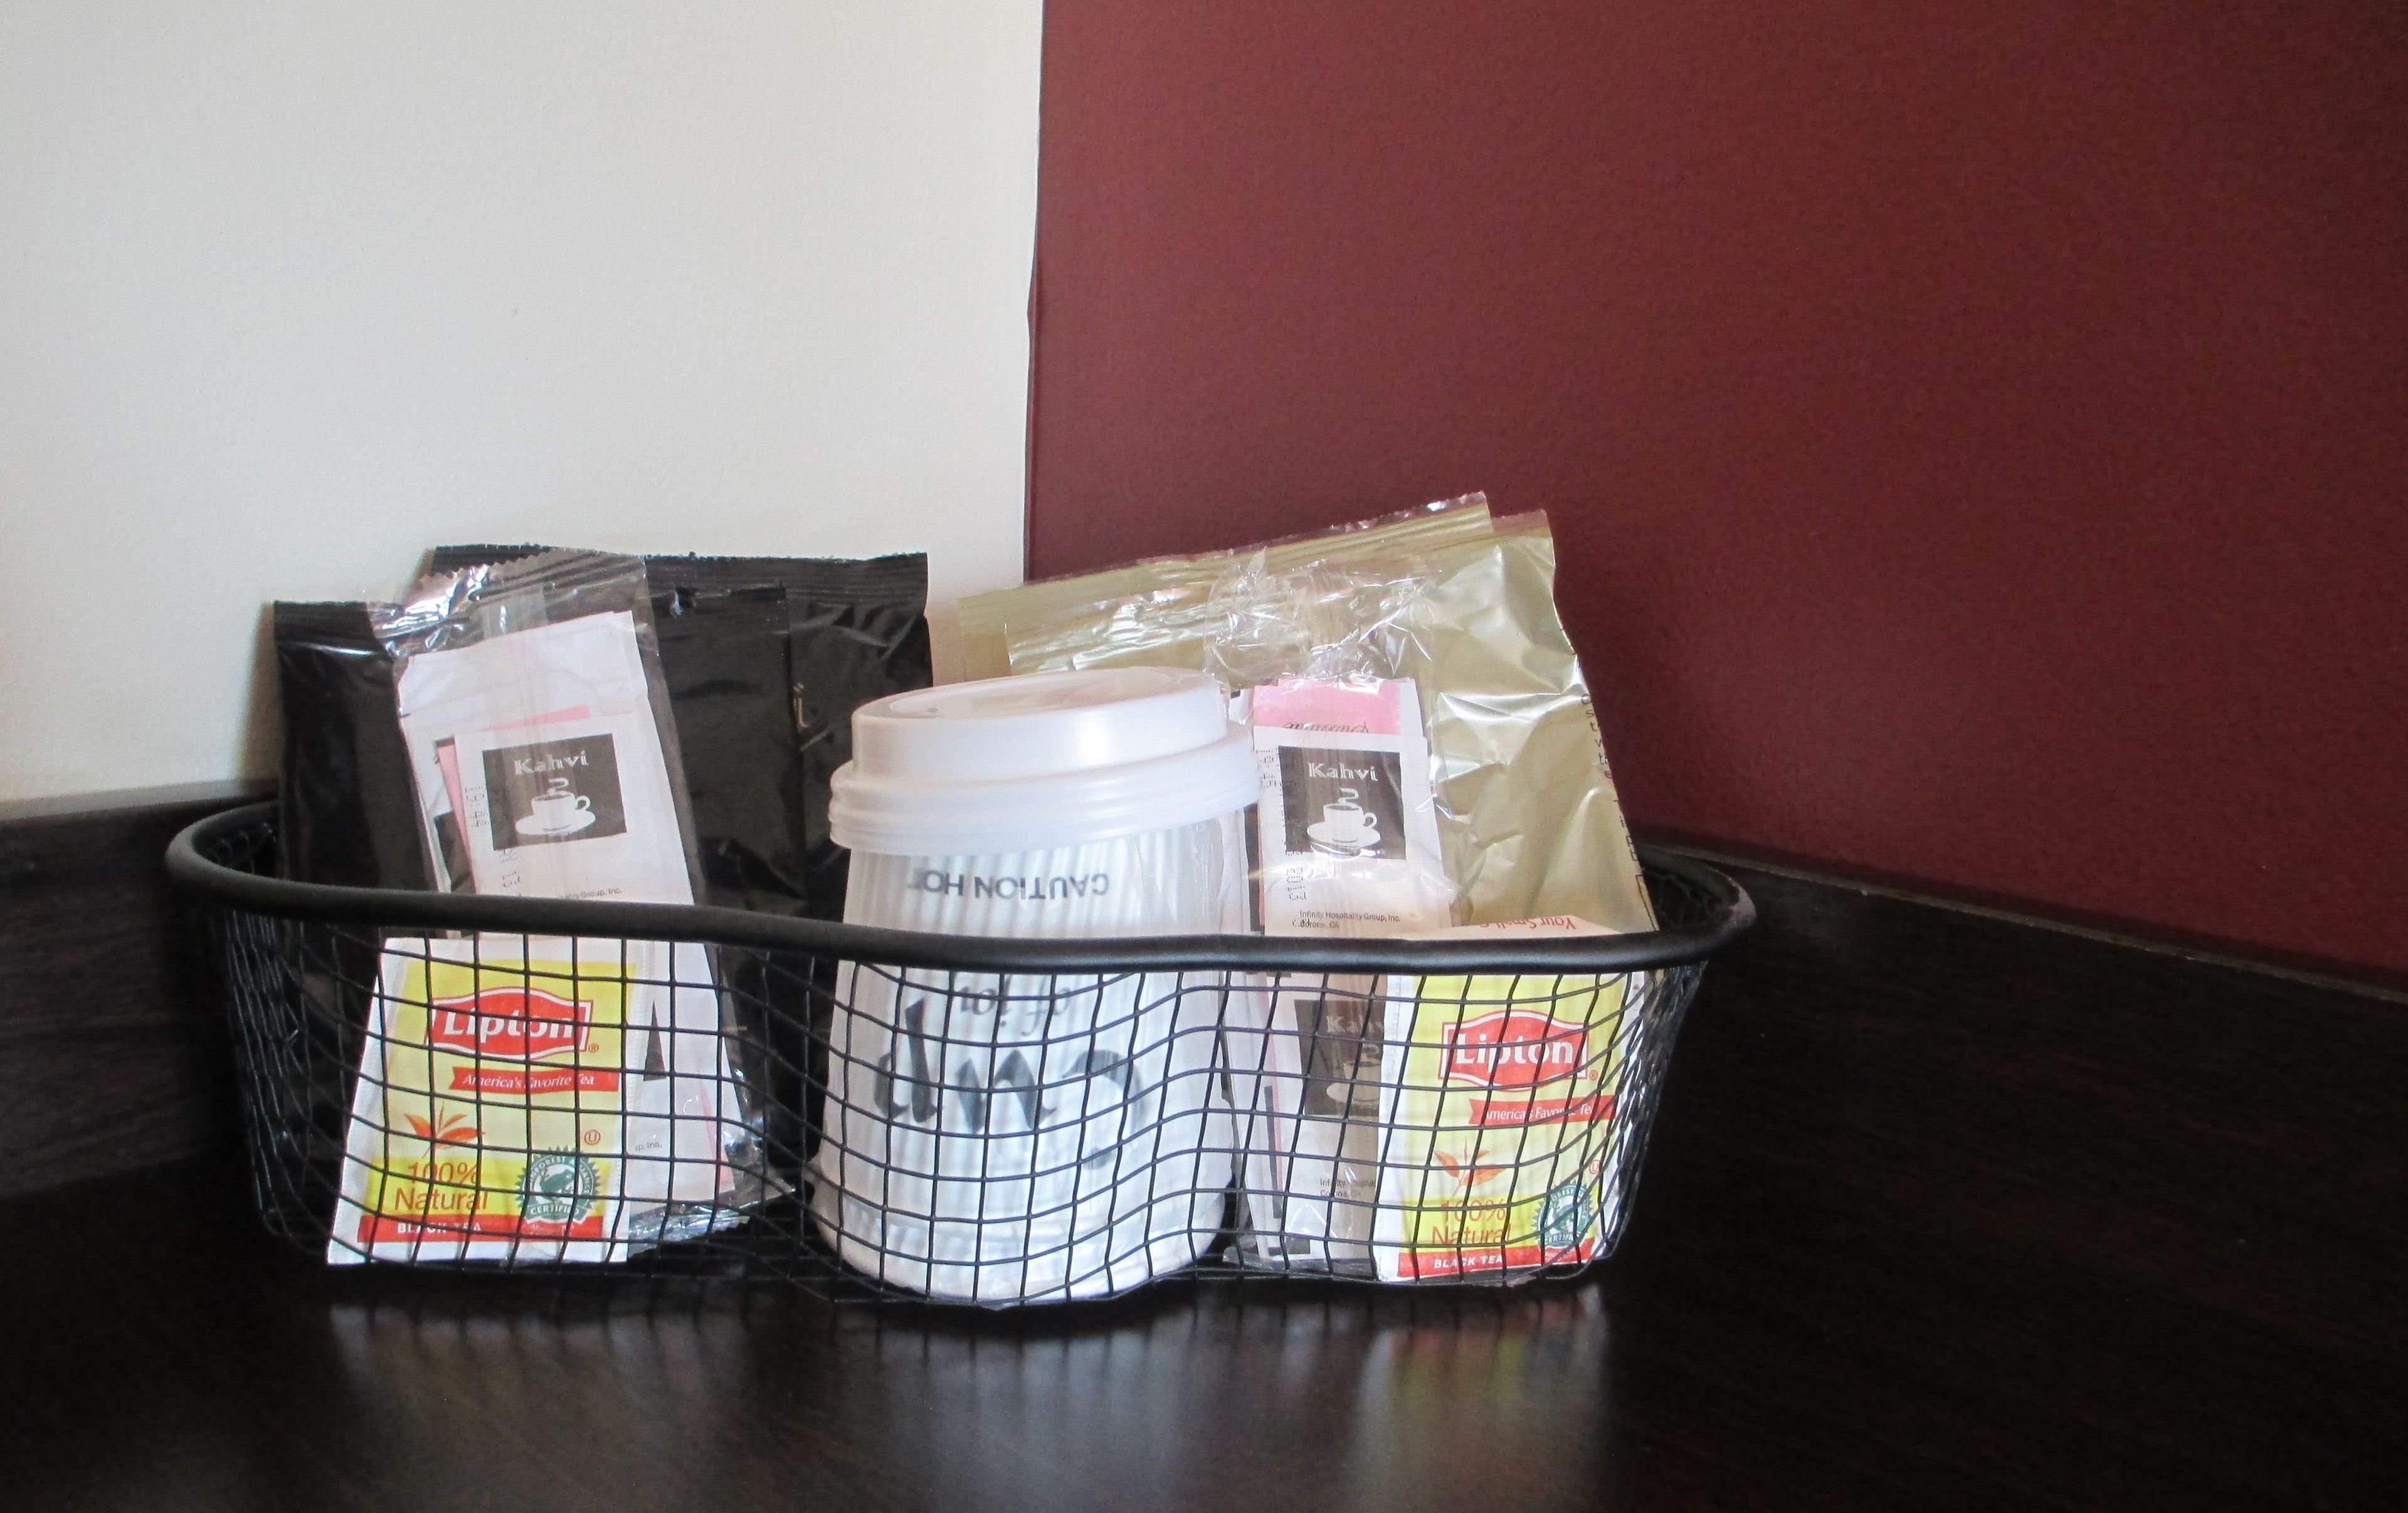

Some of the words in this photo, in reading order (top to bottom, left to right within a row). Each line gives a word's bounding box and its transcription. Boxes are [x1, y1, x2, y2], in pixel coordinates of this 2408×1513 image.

[514, 749, 589, 776] Kahvi
[1307, 761, 1380, 782] Kahvi
[974, 873, 1109, 900] CAUTION
[1363, 913, 1387, 922] Group,
[1388, 914, 1402, 922] Inc.
[1540, 917, 1576, 930] Your
[443, 1006, 574, 1044] Lipton
[1455, 1033, 1574, 1074] Lipton
[524, 1075, 571, 1089] avorite
[576, 1073, 595, 1085] ea
[1484, 1108, 1533, 1120] mericas
[408, 1161, 482, 1184] 100%
[394, 1187, 488, 1211] Natural
[1441, 1199, 1506, 1223] 100%
[1431, 1224, 1512, 1245] Natural
[1434, 1258, 1476, 1268] BLACK
[1479, 1255, 1504, 1265] TEA
